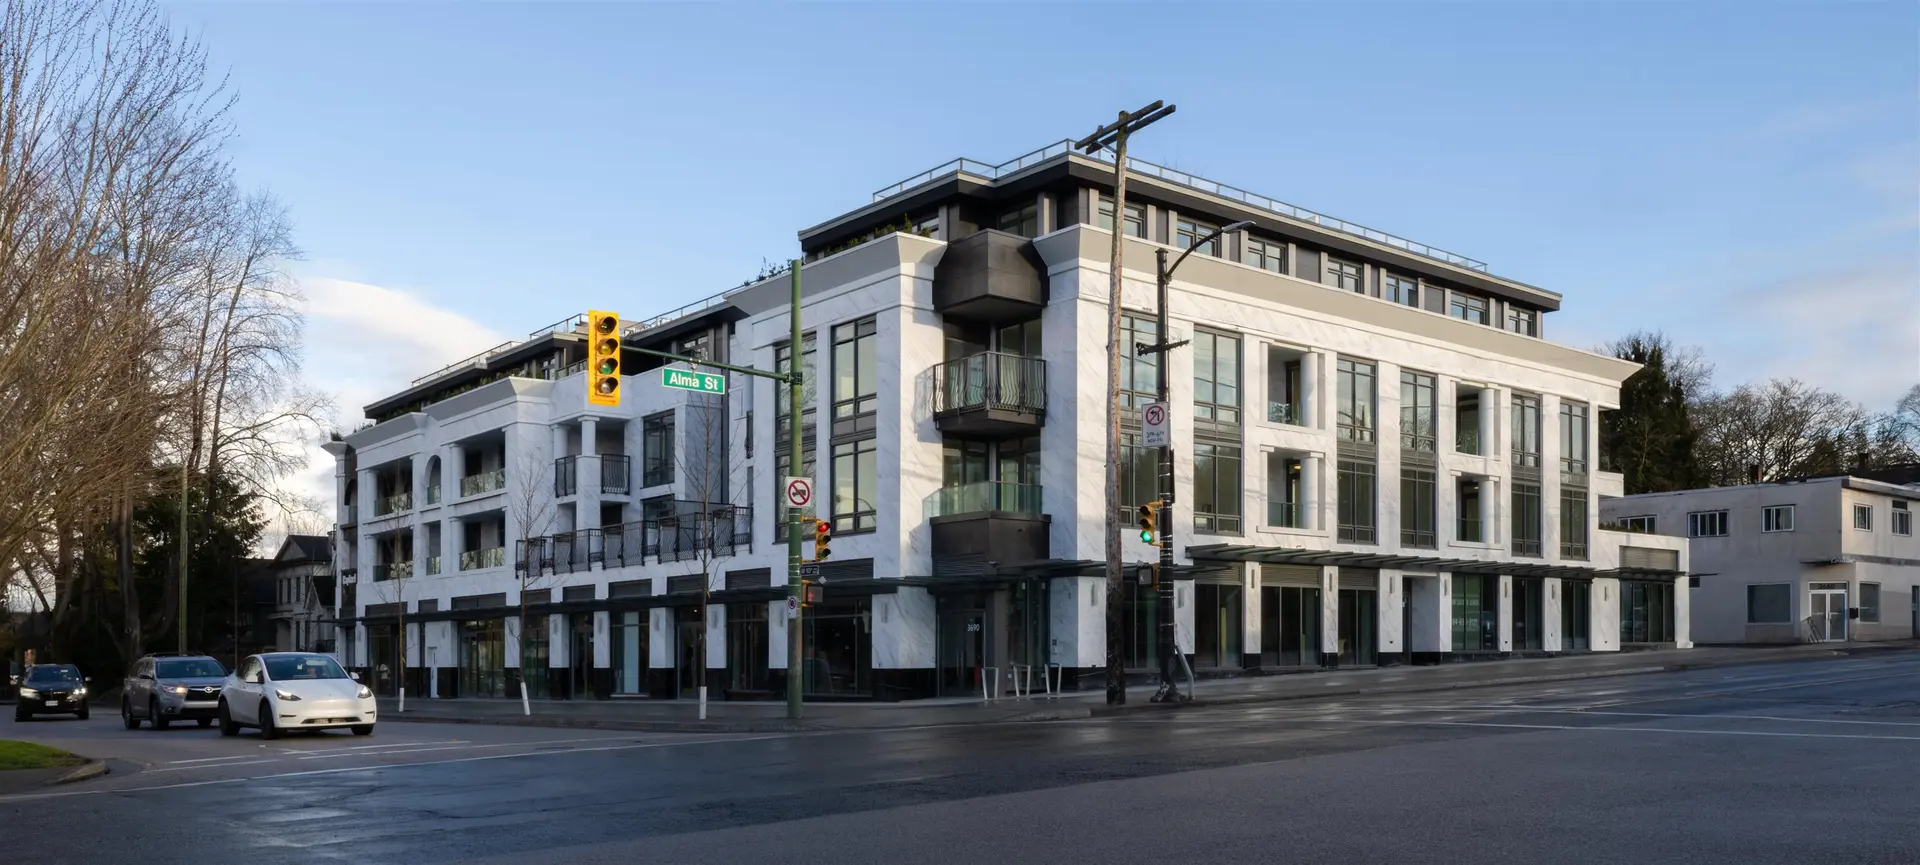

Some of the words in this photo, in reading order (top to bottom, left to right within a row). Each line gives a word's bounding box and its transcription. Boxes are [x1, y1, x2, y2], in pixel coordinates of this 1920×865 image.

[669, 372, 700, 388] Alma
[704, 376, 719, 390] St
[967, 623, 980, 632] 3690
